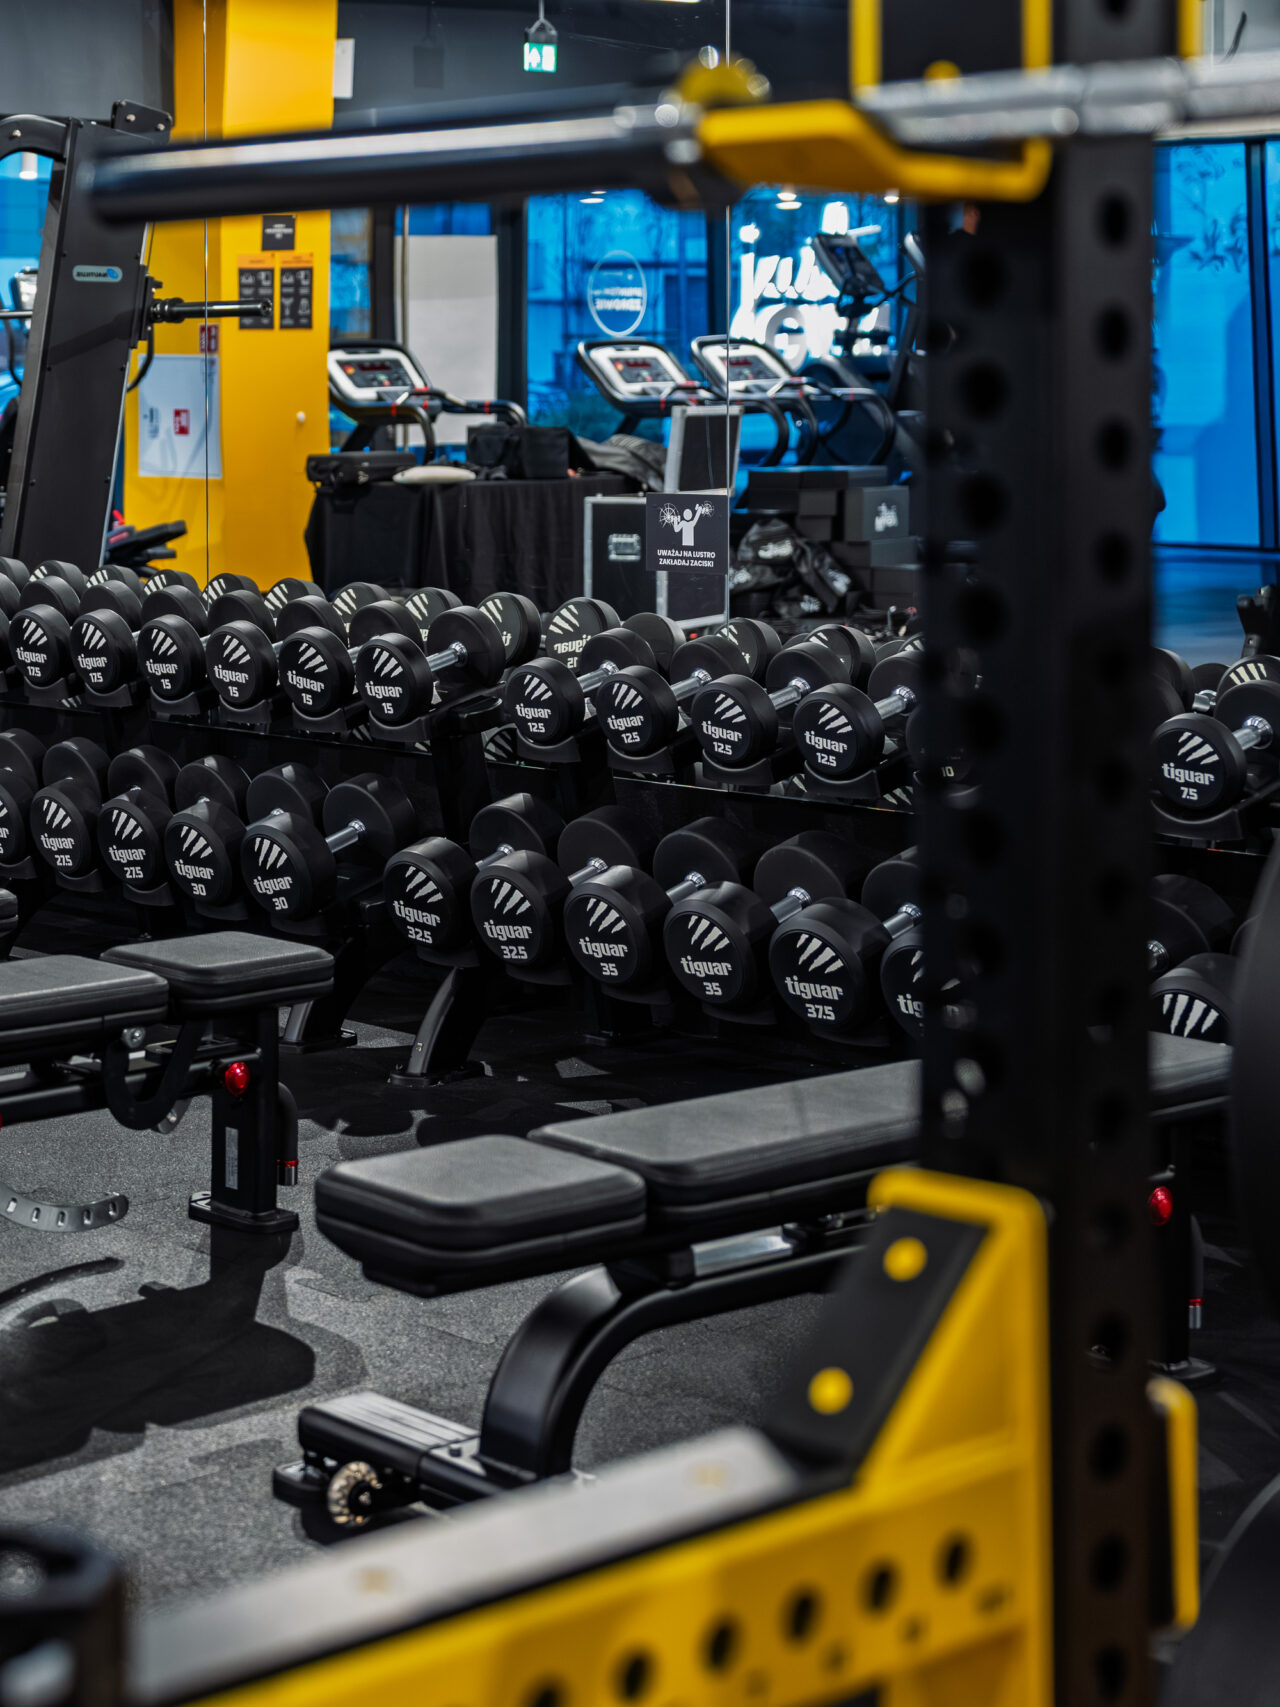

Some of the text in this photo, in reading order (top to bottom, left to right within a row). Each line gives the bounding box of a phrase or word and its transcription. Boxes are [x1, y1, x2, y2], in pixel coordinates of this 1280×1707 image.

[657, 548, 683, 557] UWAŻAJ
[693, 551, 716, 559] LUSTRO
[659, 558, 714, 568] ZAKŁADAJ ZACISKI
[16, 646, 48, 664] tiguar
[77, 653, 108, 670] tiguar
[145, 658, 179, 676] tiguar
[213, 664, 249, 684] tiguar
[160, 678, 172, 690] 15
[286, 670, 325, 693] tiguar
[365, 680, 403, 699] tiguar
[227, 685, 239, 698] 15
[301, 693, 313, 706] 15
[381, 702, 394, 714] 15
[515, 703, 552, 720] tiguar
[607, 714, 645, 731] tiguar
[701, 720, 743, 743] tiguar
[804, 730, 848, 754] tiguar
[1162, 762, 1215, 786] tiguar
[40, 832, 75, 851] tiguar
[108, 845, 146, 864] tiguar
[174, 858, 215, 880] tiguar
[191, 883, 207, 896] 30
[253, 874, 293, 895] tiguar
[272, 896, 289, 911] 30
[392, 899, 441, 927] tiguar
[483, 919, 533, 941] tiguar
[578, 936, 629, 959] tiguar
[600, 962, 618, 976] 35
[680, 955, 732, 978] tiguar
[703, 981, 722, 996] 35
[784, 975, 844, 1001] tiguar
